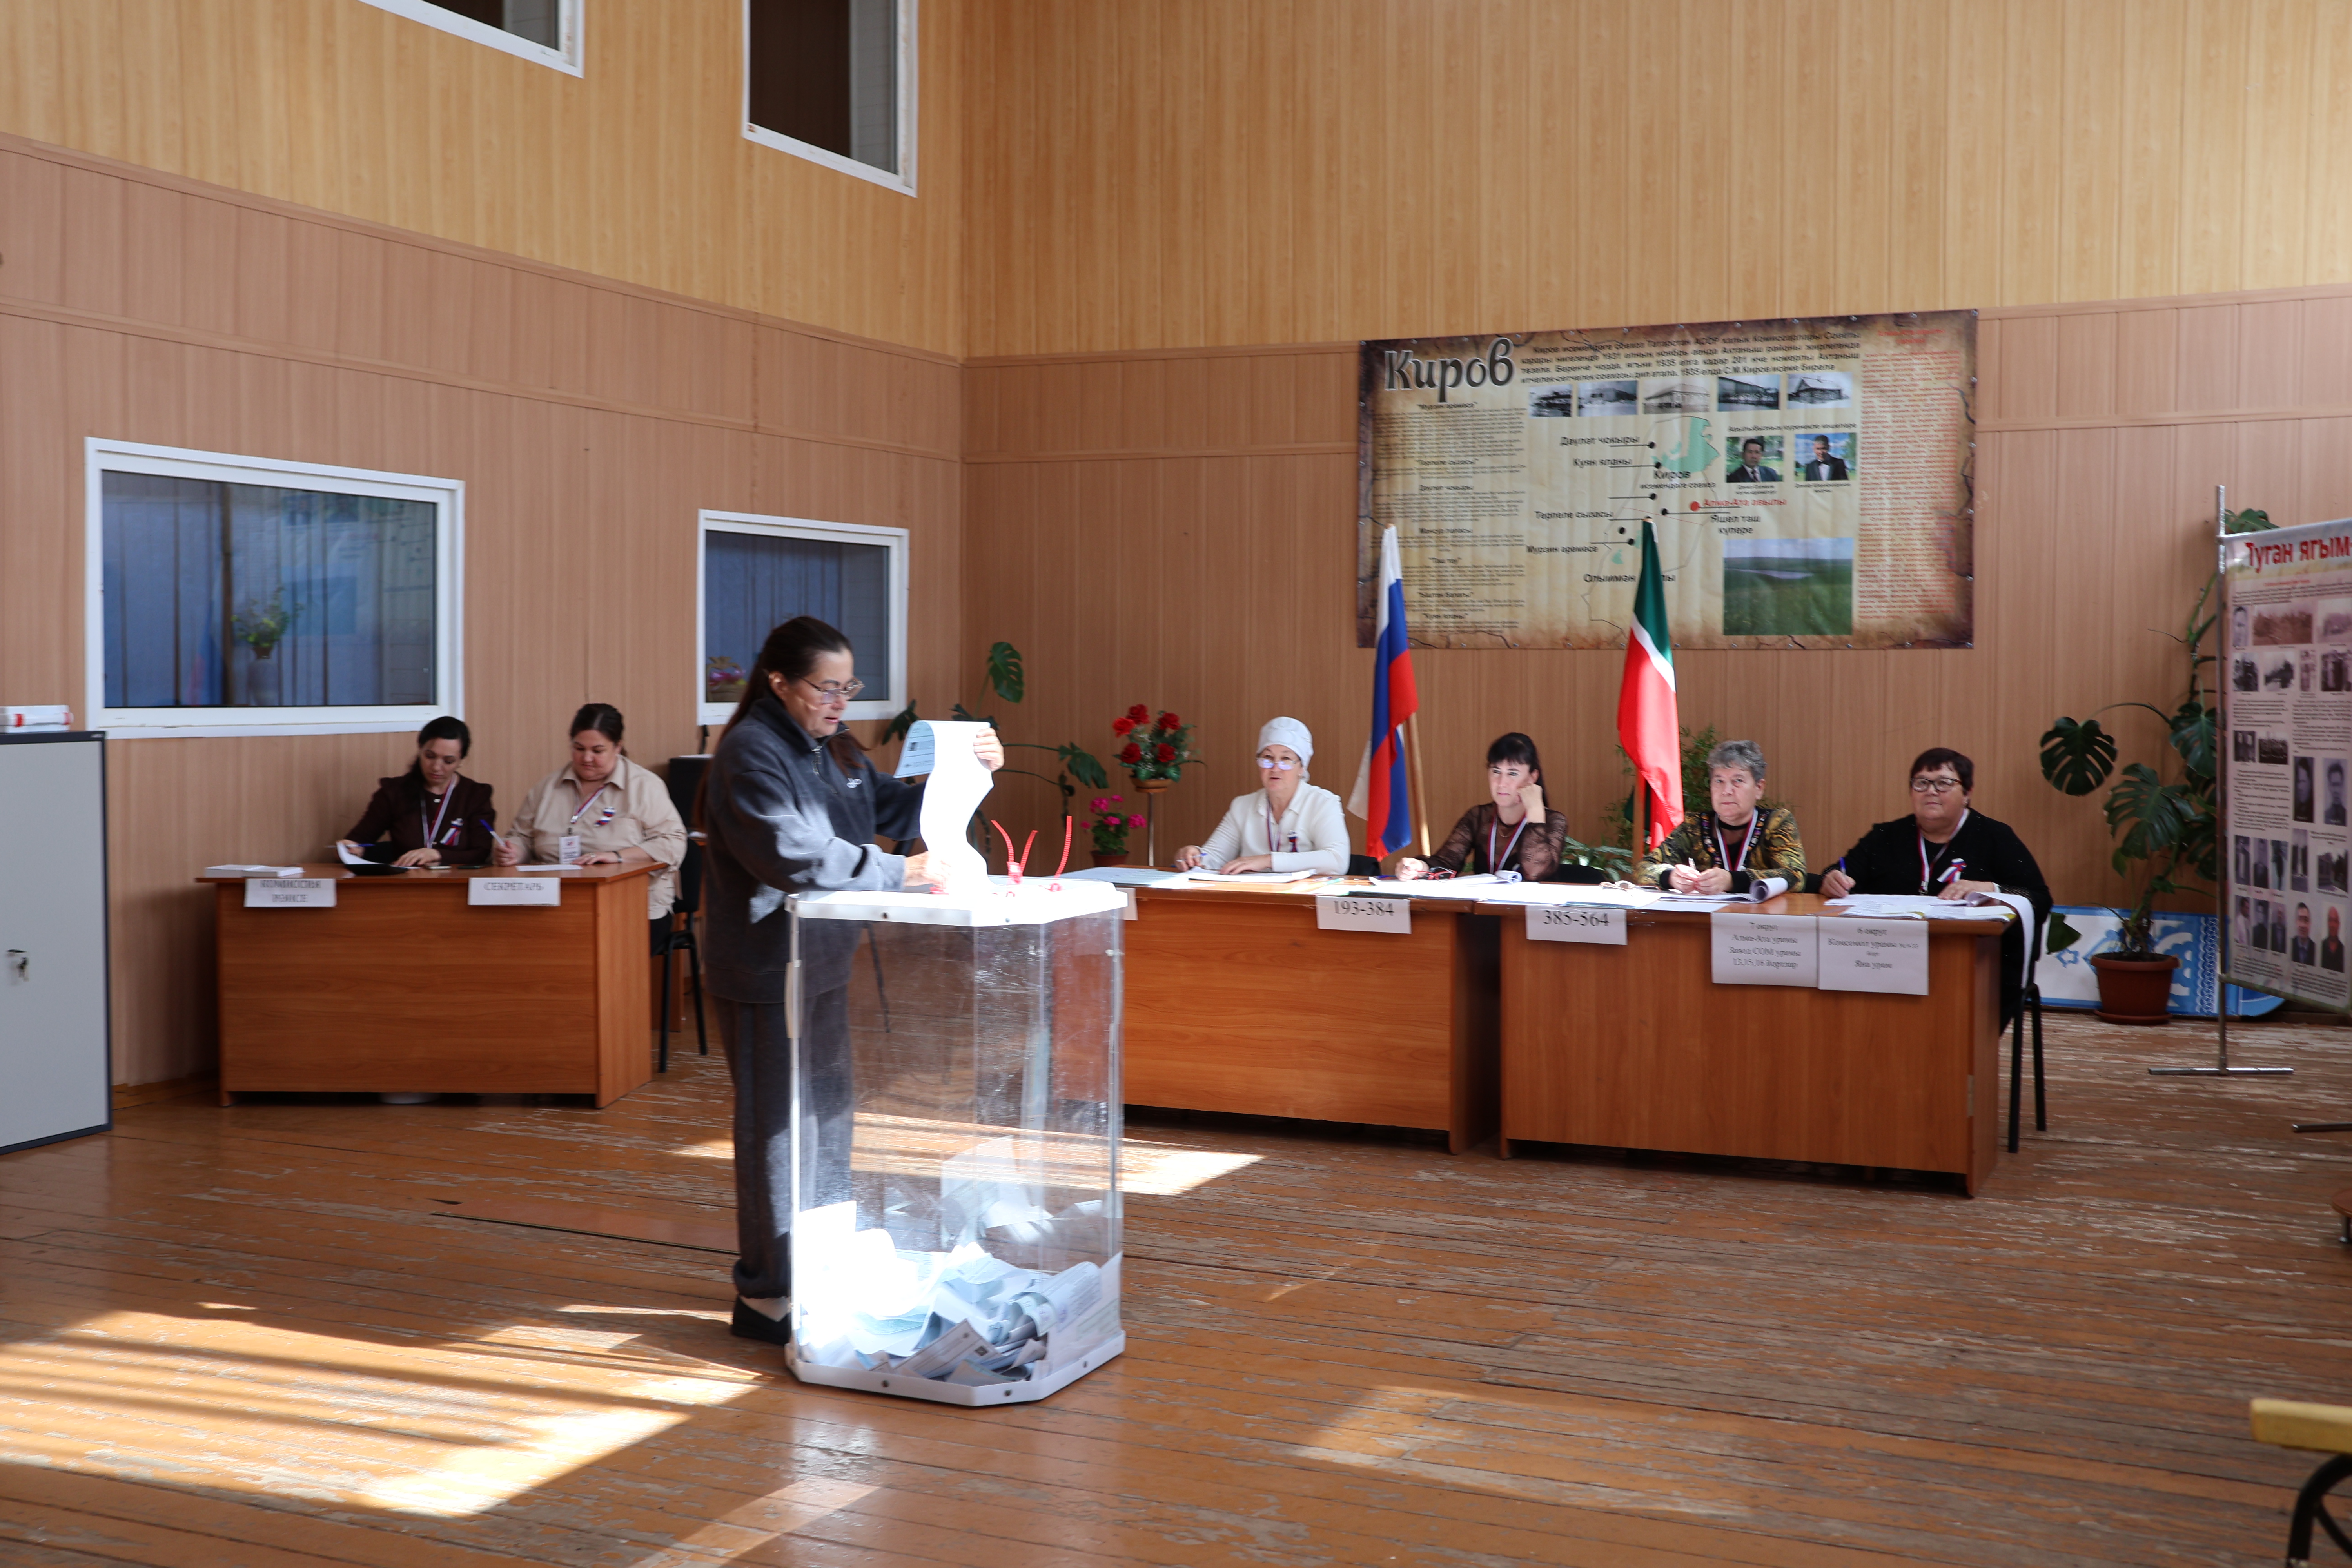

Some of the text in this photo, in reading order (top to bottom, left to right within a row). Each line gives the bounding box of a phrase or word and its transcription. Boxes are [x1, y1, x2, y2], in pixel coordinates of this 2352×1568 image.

[1385, 338, 1516, 403] Киров
[1598, 436, 1640, 446] чокыры
[1573, 458, 1597, 468] Куян
[1653, 470, 1691, 481] Киров
[1703, 498, 1750, 507] Алма-Ата
[1710, 514, 1739, 523] Яшел
[2245, 541, 2293, 574] Туган
[483, 882, 544, 891] СЕКРЕТАРЬ
[1332, 900, 1395, 916] 193-384
[1543, 910, 1610, 927] 385-564
[1732, 934, 1798, 945] Алма-Ата урамы
[1828, 938, 1869, 947] Комсомол
[1728, 946, 1752, 955] Завод
[1871, 962, 1893, 970] урам
